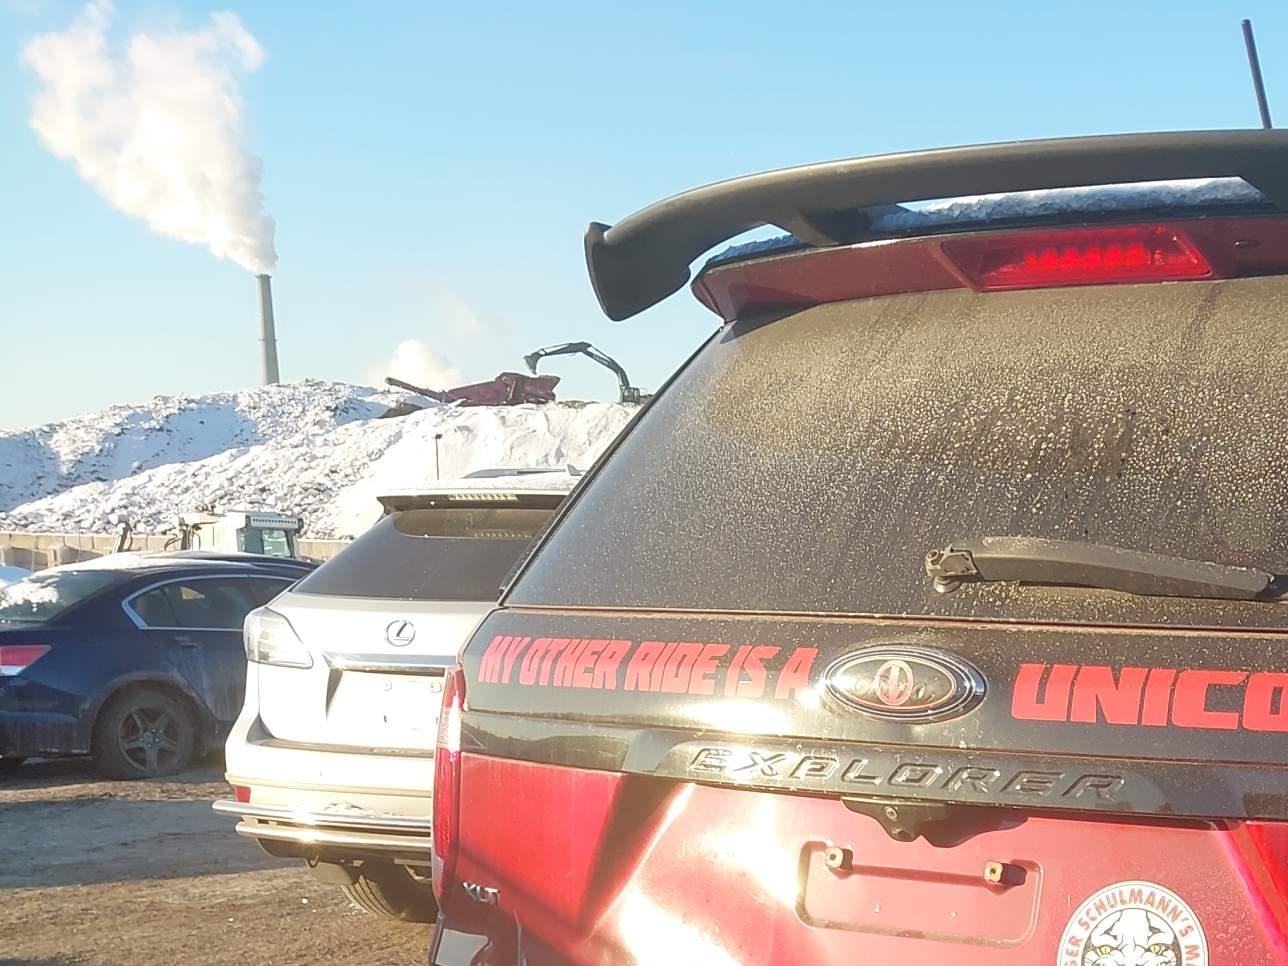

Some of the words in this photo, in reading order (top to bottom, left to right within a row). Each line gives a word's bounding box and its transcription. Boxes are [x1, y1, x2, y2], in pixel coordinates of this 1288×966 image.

[479, 636, 530, 683] MY
[519, 638, 632, 689] OTHER
[624, 642, 731, 695] RIDE
[724, 645, 782, 698] IS
[774, 648, 818, 699] A
[689, 747, 1126, 801] EXPLORER
[462, 881, 499, 905] XLT
[1078, 887, 1194, 938] SCHULMANN'S
